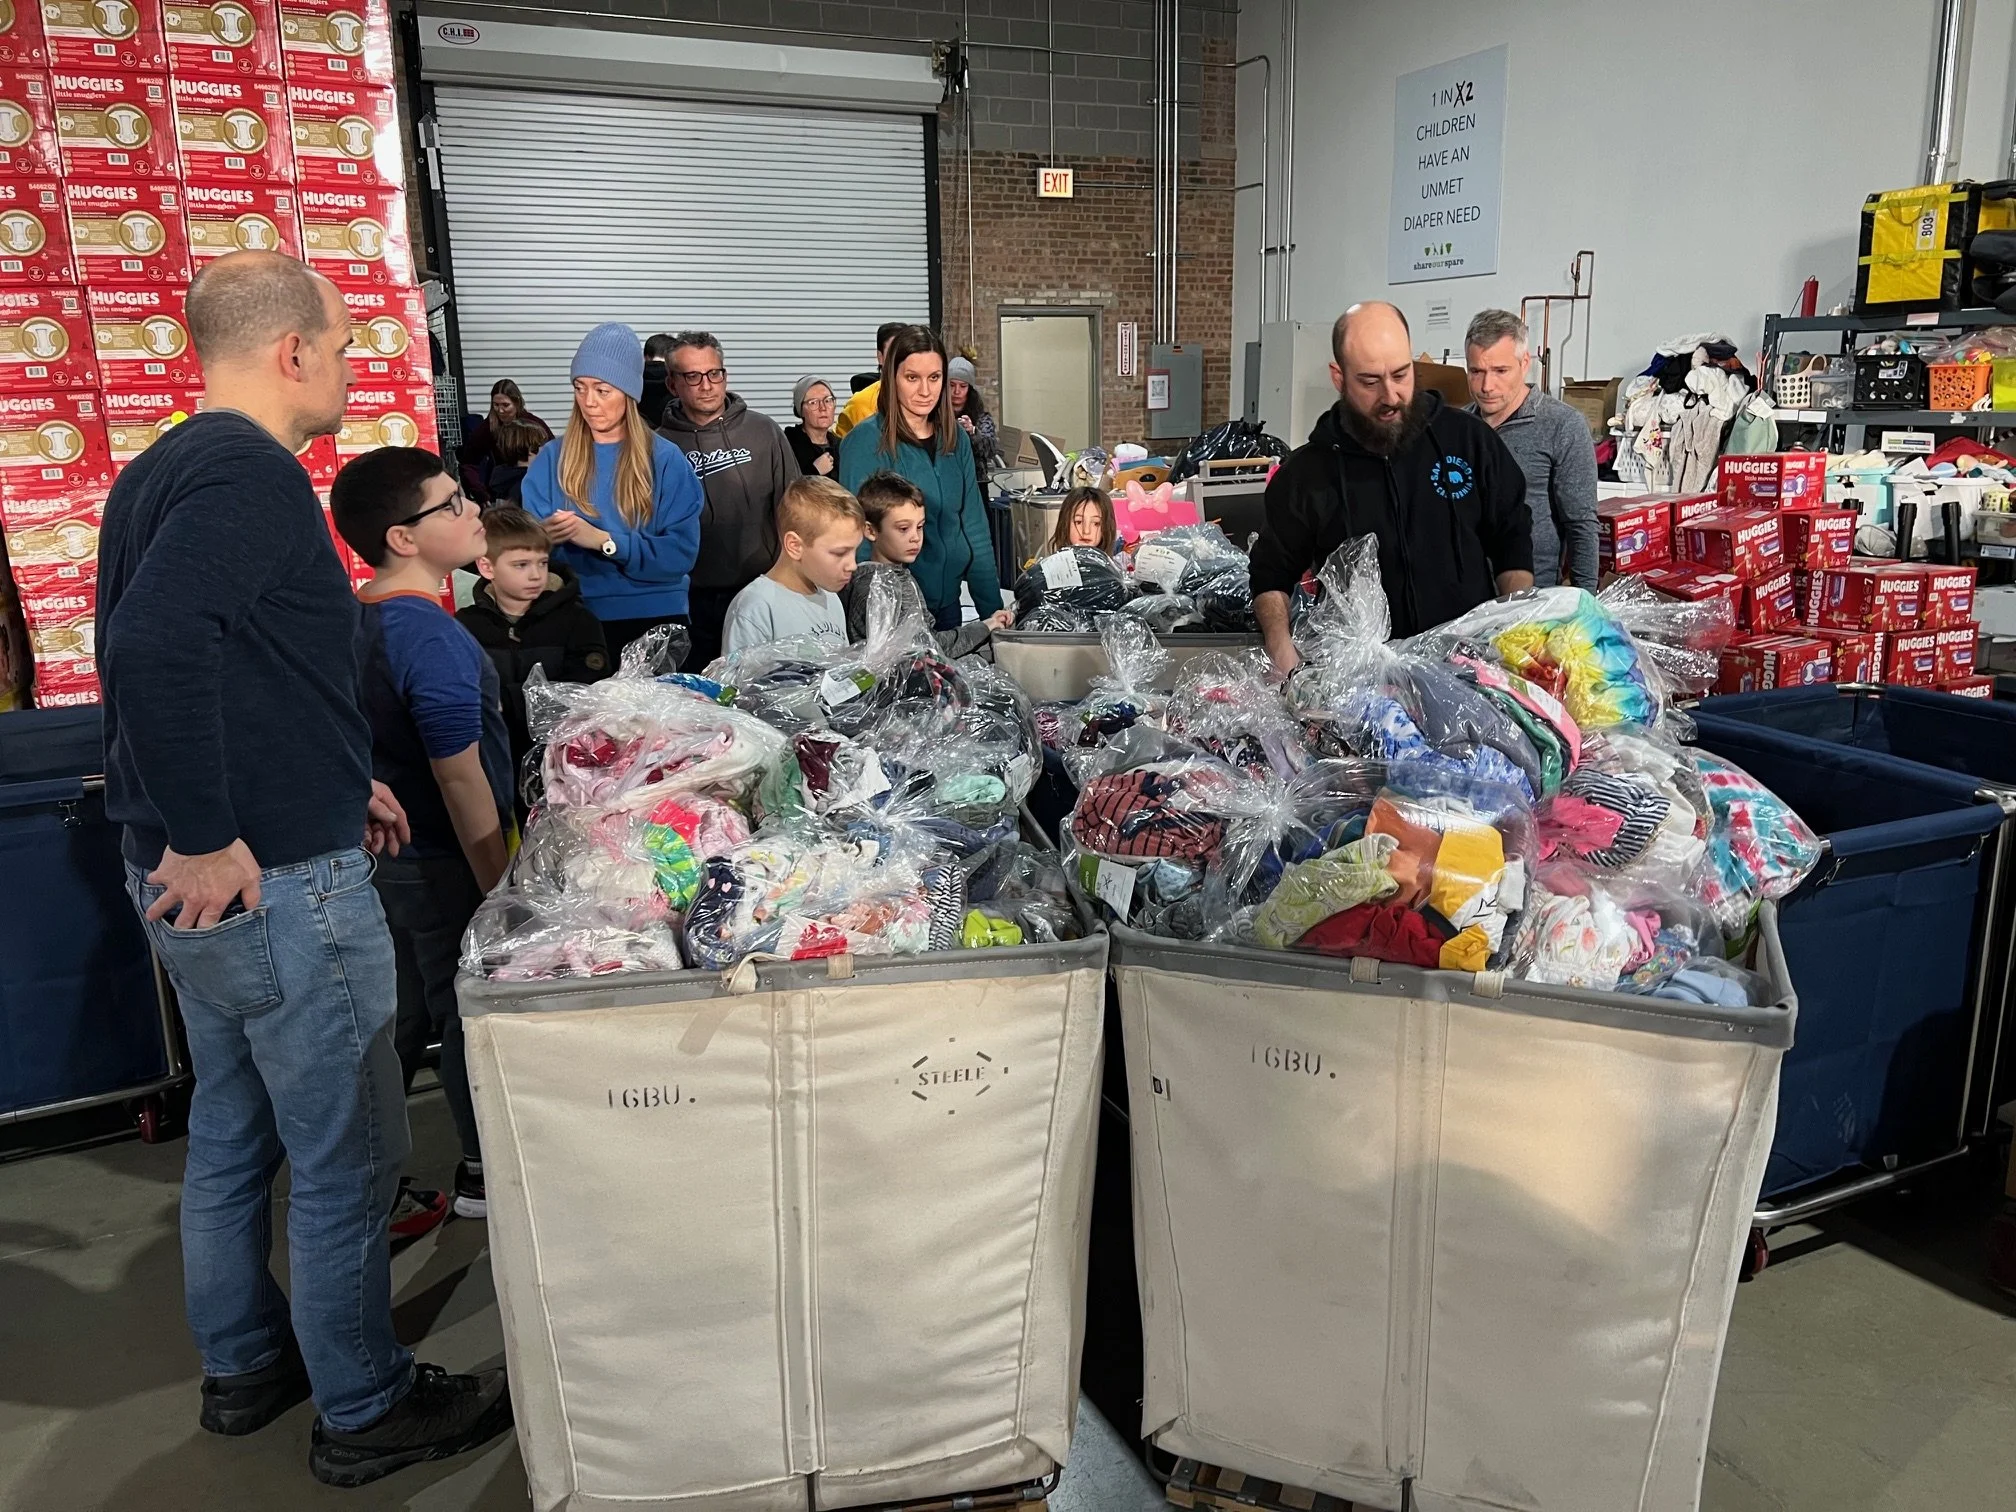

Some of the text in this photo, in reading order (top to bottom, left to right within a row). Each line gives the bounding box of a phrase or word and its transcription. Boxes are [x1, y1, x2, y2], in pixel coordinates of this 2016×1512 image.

[32, 49, 40, 58] 6
[153, 54, 162, 64] 6
[269, 62, 277, 71] 6
[53, 74, 124, 92] HUGGIES
[176, 80, 242, 97] HUGGIES
[291, 86, 356, 105] HUGGIES
[1431, 92, 1436, 107] 1
[1440, 88, 1453, 106] IN
[1416, 113, 1476, 141] CHILDREN
[1418, 145, 1470, 170] HAVE AN
[167, 162, 174, 171] 6
[281, 167, 288, 176] 6
[1044, 173, 1069, 193] EXIT
[1421, 177, 1464, 199] UNMET
[68, 184, 138, 200] HUGGIES
[187, 187, 254, 203] HUGGIES
[302, 190, 367, 207] HUGGIES
[1404, 205, 1481, 231] DIAPER NEED
[1921, 217, 1934, 237] 803
[62, 267, 70, 276] 6
[180, 267, 188, 276] 6
[0, 292, 40, 307] GGIES
[91, 290, 160, 305] HUGGIES
[343, 292, 385, 306] GGIES
[86, 371, 93, 380] 6
[0, 398, 55, 412] UGGIES
[106, 394, 173, 408] HUGGIES
[347, 391, 396, 404] UGGIES
[325, 464, 332, 473] 6
[1445, 455, 1472, 475] DIEGO
[1725, 461, 1778, 474] HUGGIES
[101, 472, 107, 481] 6
[1436, 482, 1472, 499] CAFORNIA
[1681, 499, 1717, 519] HUGGIES
[1773, 501, 1778, 509] 7
[1617, 516, 1643, 530] HUGGIES
[1737, 517, 1778, 544] HUGGIES
[1814, 517, 1851, 532] HUGGIES
[1778, 553, 1784, 564] 7
[1846, 555, 1851, 565] 7
[1756, 572, 1791, 600] HUGGIES
[1880, 580, 1919, 593] HUGGIES
[1933, 575, 1971, 590] HUGGIES
[1806, 570, 1824, 627] HUGGIES
[1791, 608, 1796, 617] 7
[1966, 613, 1971, 623] 7
[1913, 619, 1918, 629] 7
[1897, 635, 1934, 651] HUGGIES
[1936, 629, 1974, 645] HUGGIES
[1872, 632, 1883, 683] HUGGIE
[1762, 650, 1776, 689] HUGG
[1968, 667, 1974, 676] 7
[1928, 674, 1933, 683] 7
[919, 1066, 984, 1086] STEELE
